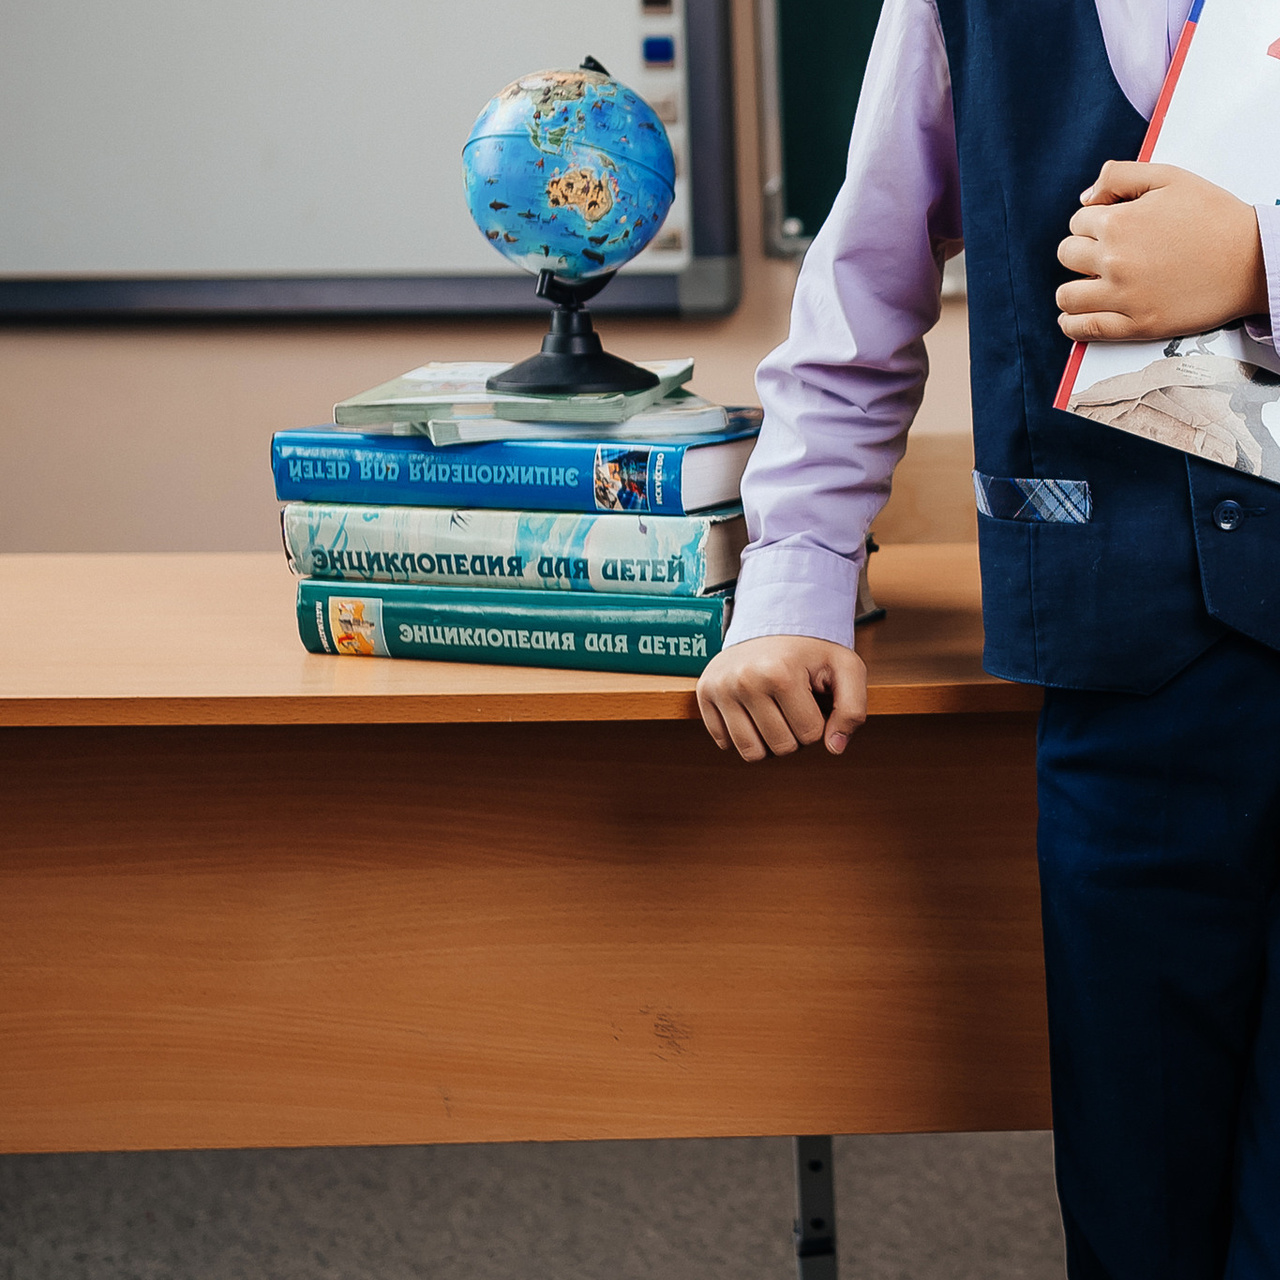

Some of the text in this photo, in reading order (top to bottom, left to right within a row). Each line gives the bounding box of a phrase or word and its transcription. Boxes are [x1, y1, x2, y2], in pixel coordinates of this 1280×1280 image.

[287, 458, 580, 488] ЭНЦИКЛОПЕДИЯ ДЛЯ ДЕТЕЙ
[310, 549, 686, 584] ЭНЦИКЛОПЕДИЯ ДЛЯ ДЕТЕЙ
[398, 623, 708, 658] ЭНЦИКЛОПЕДИЯ ДЛЯ ДЕТЕЙ
